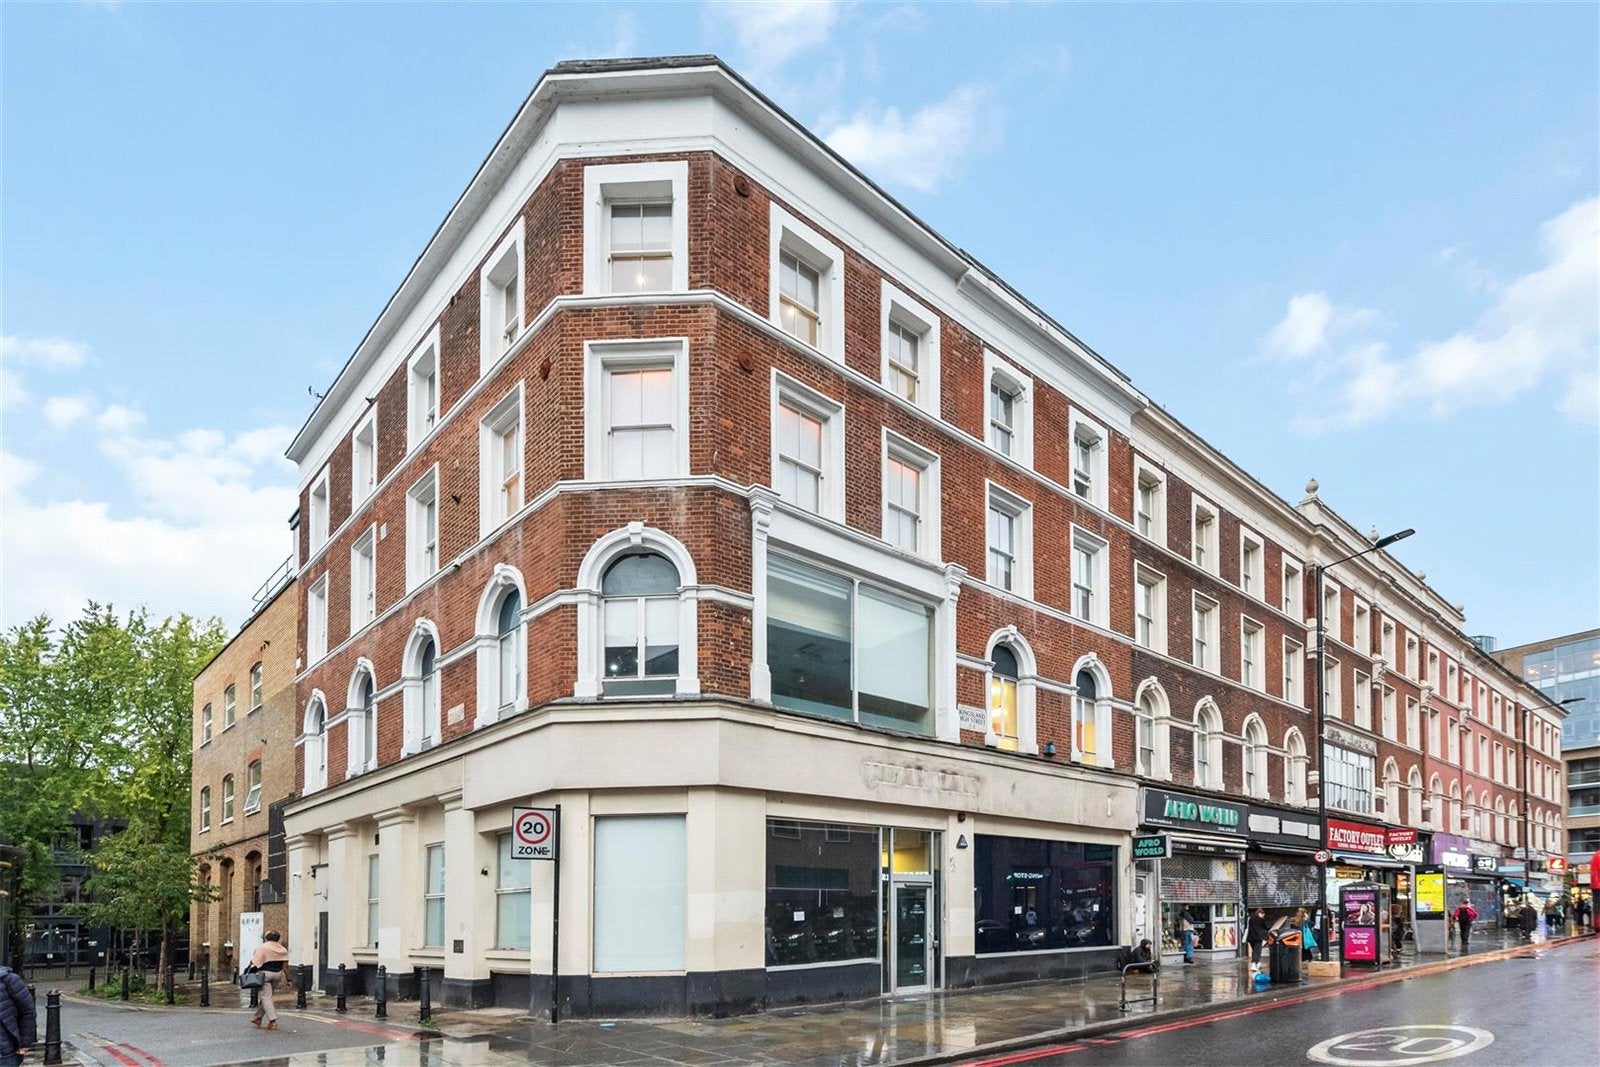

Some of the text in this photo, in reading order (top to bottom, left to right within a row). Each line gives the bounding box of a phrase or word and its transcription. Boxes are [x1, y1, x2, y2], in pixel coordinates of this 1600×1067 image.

[1164, 799, 1239, 826] AFRO WORLD
[522, 821, 544, 835] 20
[1138, 838, 1161, 848] AFRO
[1329, 827, 1360, 845] FACTORY
[1360, 832, 1385, 848] OUTLET
[518, 845, 550, 856] ZONE
[1134, 847, 1164, 857] WORLD
[1333, 1034, 1466, 1055] 20
